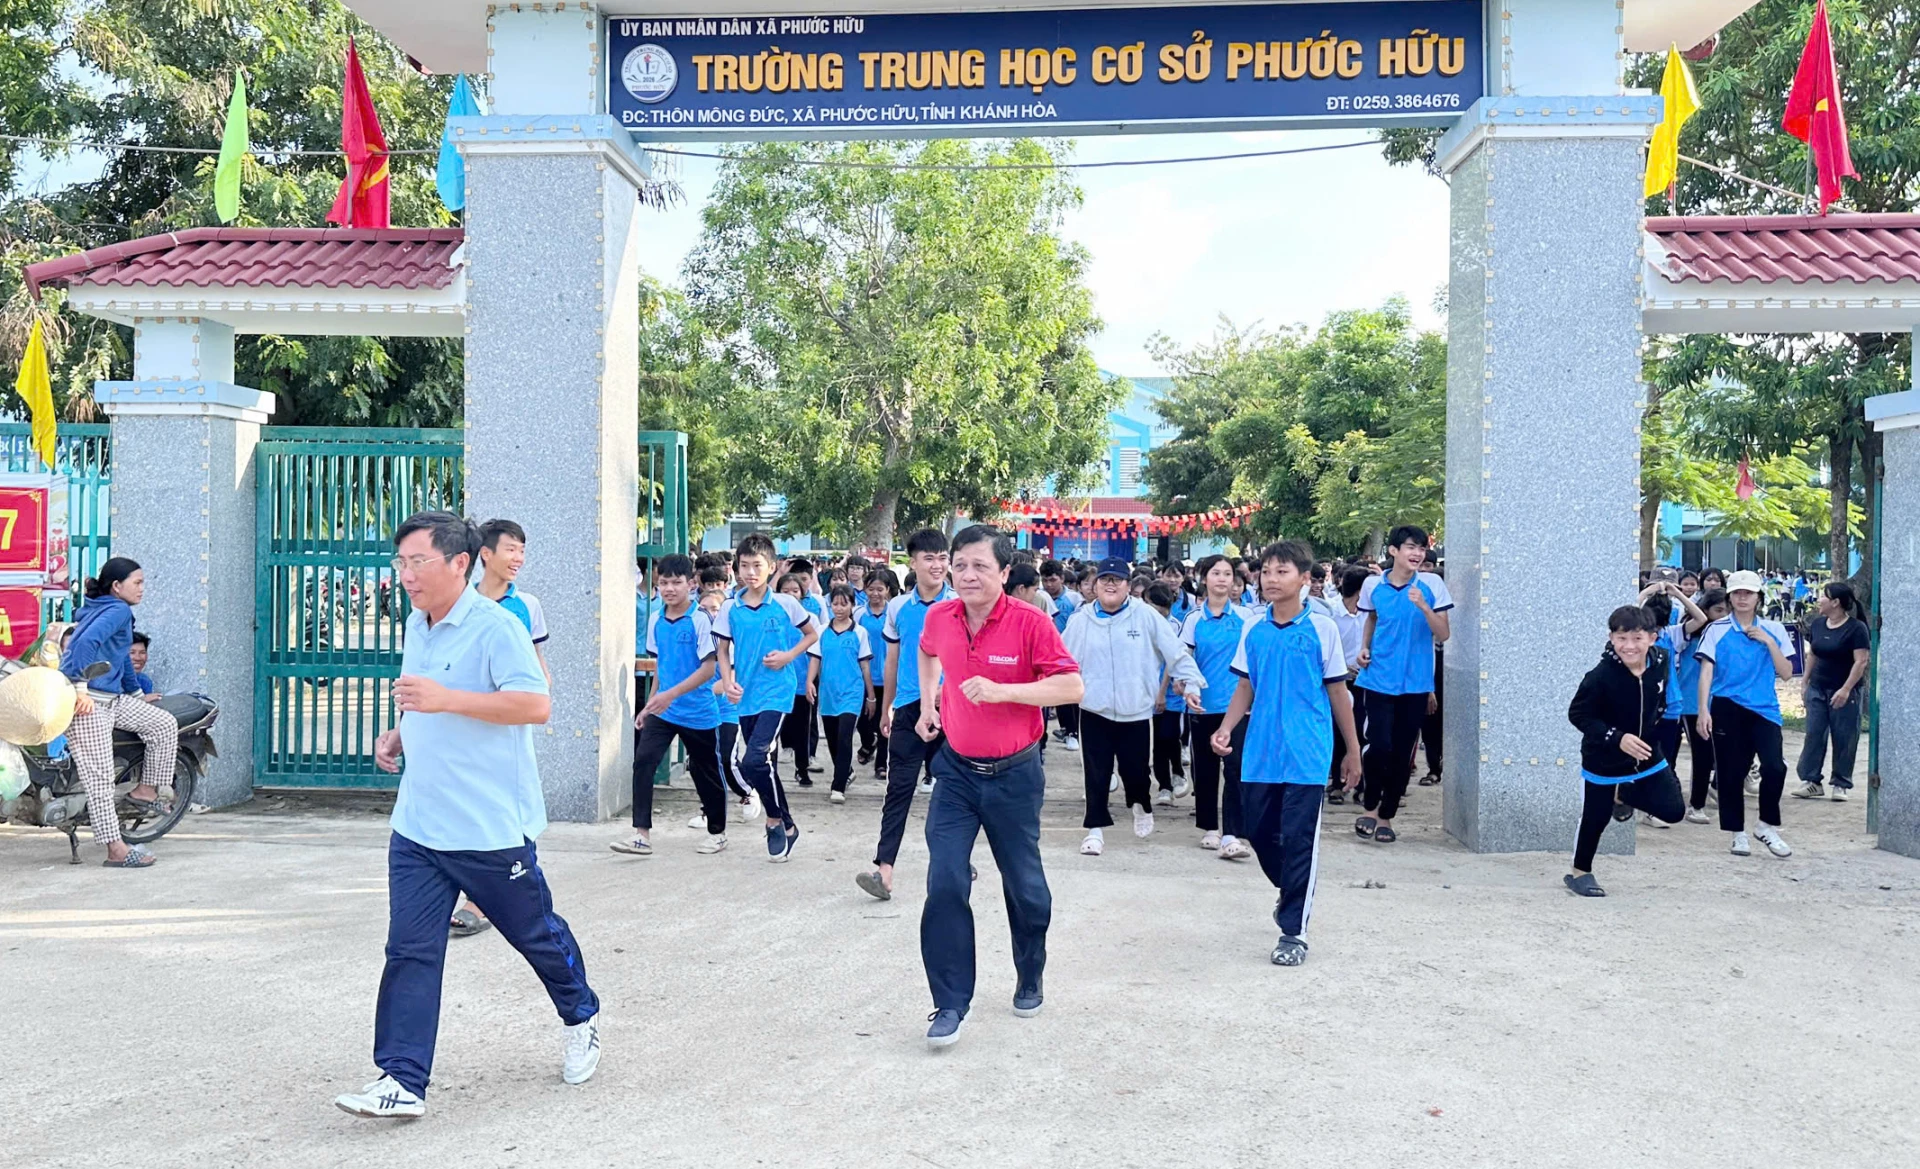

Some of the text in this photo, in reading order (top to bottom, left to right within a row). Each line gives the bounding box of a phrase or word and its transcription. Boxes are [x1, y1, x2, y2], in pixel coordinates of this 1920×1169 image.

[642, 22, 673, 36] BAN
[676, 18, 717, 36] NHÂN
[721, 18, 752, 35] DÂN
[756, 17, 777, 35] XÃ
[781, 16, 830, 34] PHƯỚC
[833, 16, 864, 34] HỮU
[691, 28, 1466, 94] TRƯỜNG TRUNG HỌC CƠ SỞ PHƯỚC HỮU
[622, 101, 1058, 124] ĐC: THÔN MÔNG ĐỨC, XÃ PHƯỚC HỮU, TỈNH KHÁNH HÒA
[1326, 93, 1461, 111] ĐT: 0259.3864676
[0, 509, 18, 550] 7
